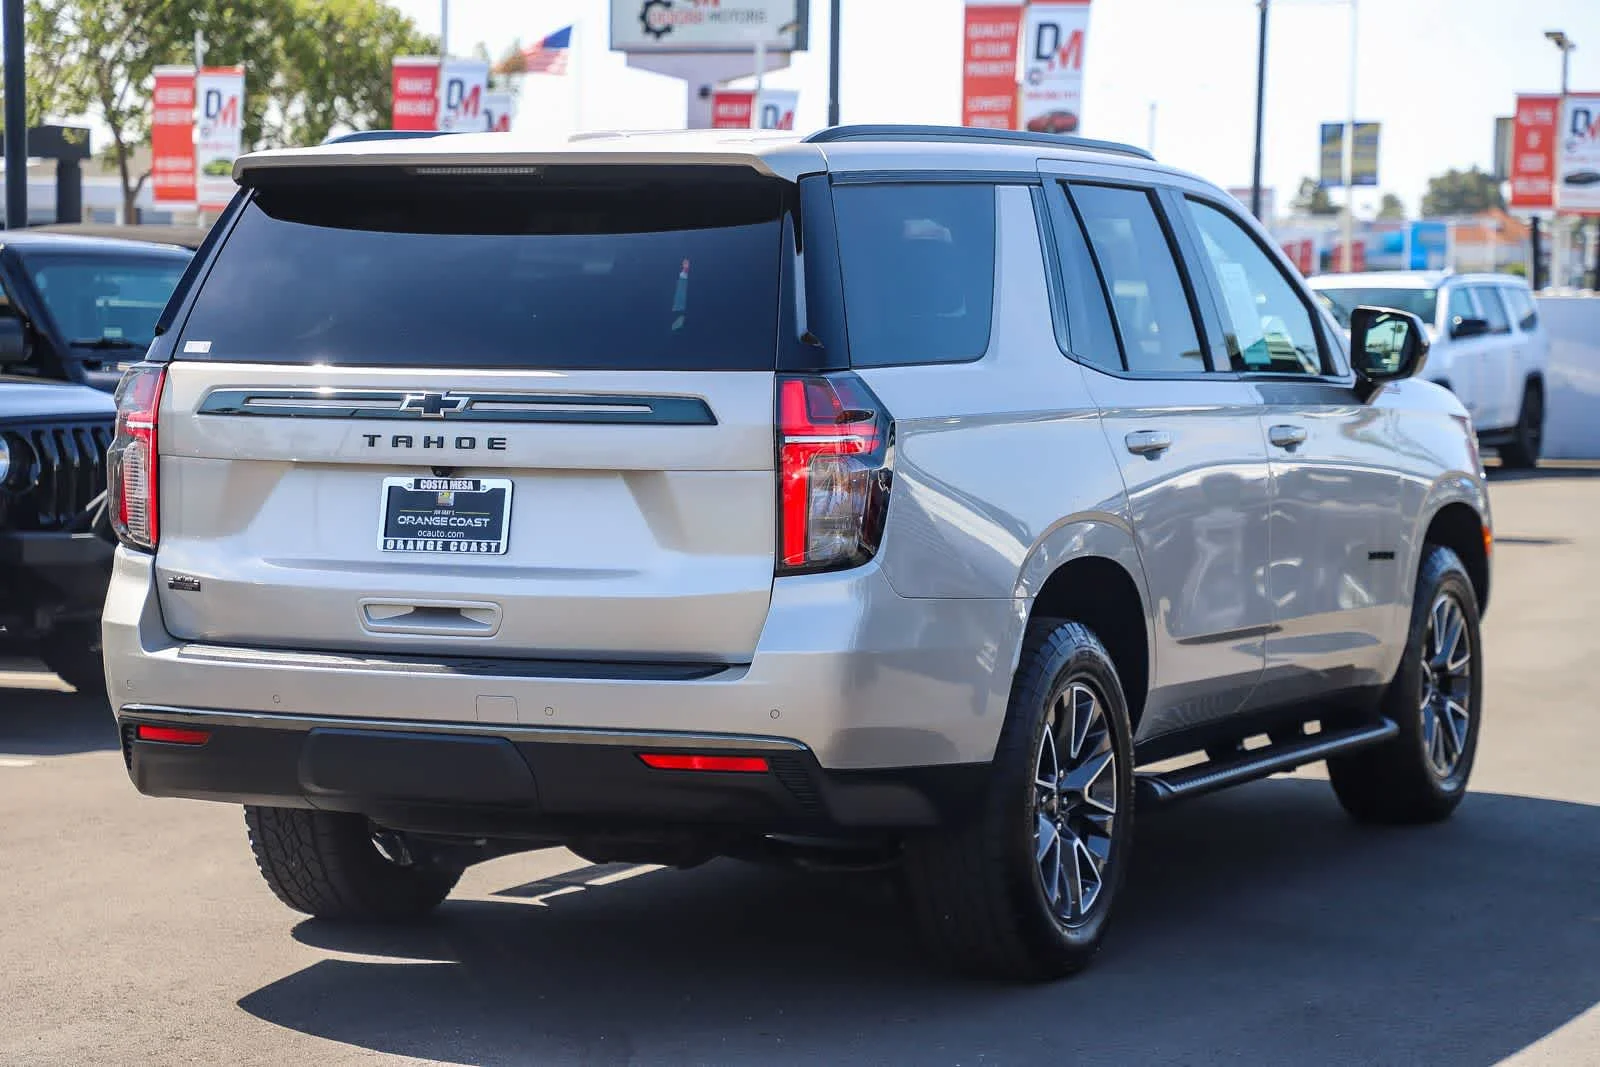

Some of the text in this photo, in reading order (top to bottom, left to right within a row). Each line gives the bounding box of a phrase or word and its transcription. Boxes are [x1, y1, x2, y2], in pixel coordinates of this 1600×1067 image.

[362, 434, 507, 450] TAHOE
[420, 479, 474, 491] COSTA MESA
[397, 515, 490, 528] ORANGE COAST
[417, 529, 465, 538] ocauto.com
[386, 540, 498, 552] ORANGE COAST
